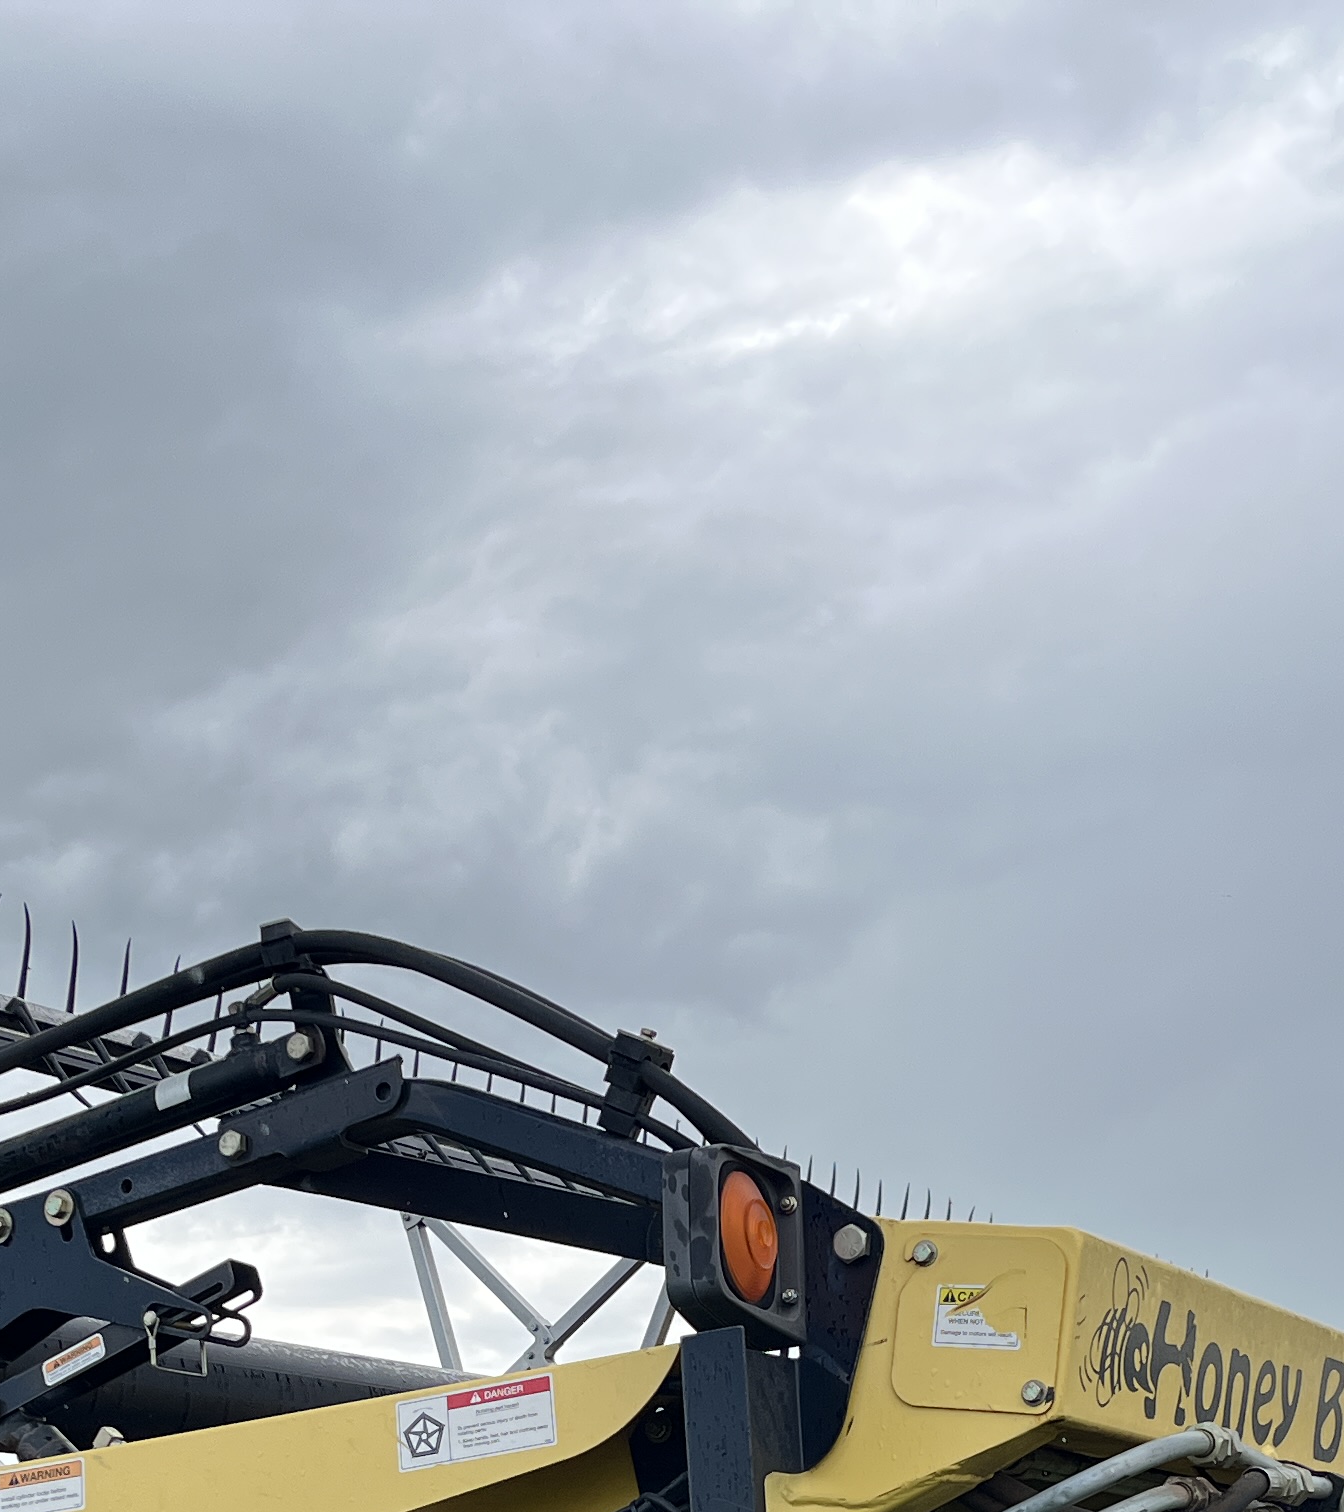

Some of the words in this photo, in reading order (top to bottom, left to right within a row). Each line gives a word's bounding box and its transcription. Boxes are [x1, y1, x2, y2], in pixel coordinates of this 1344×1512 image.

[1144, 1300, 1302, 1449] Honey
[484, 1384, 524, 1400] DANGER
[19, 1465, 71, 1483] WARNING
